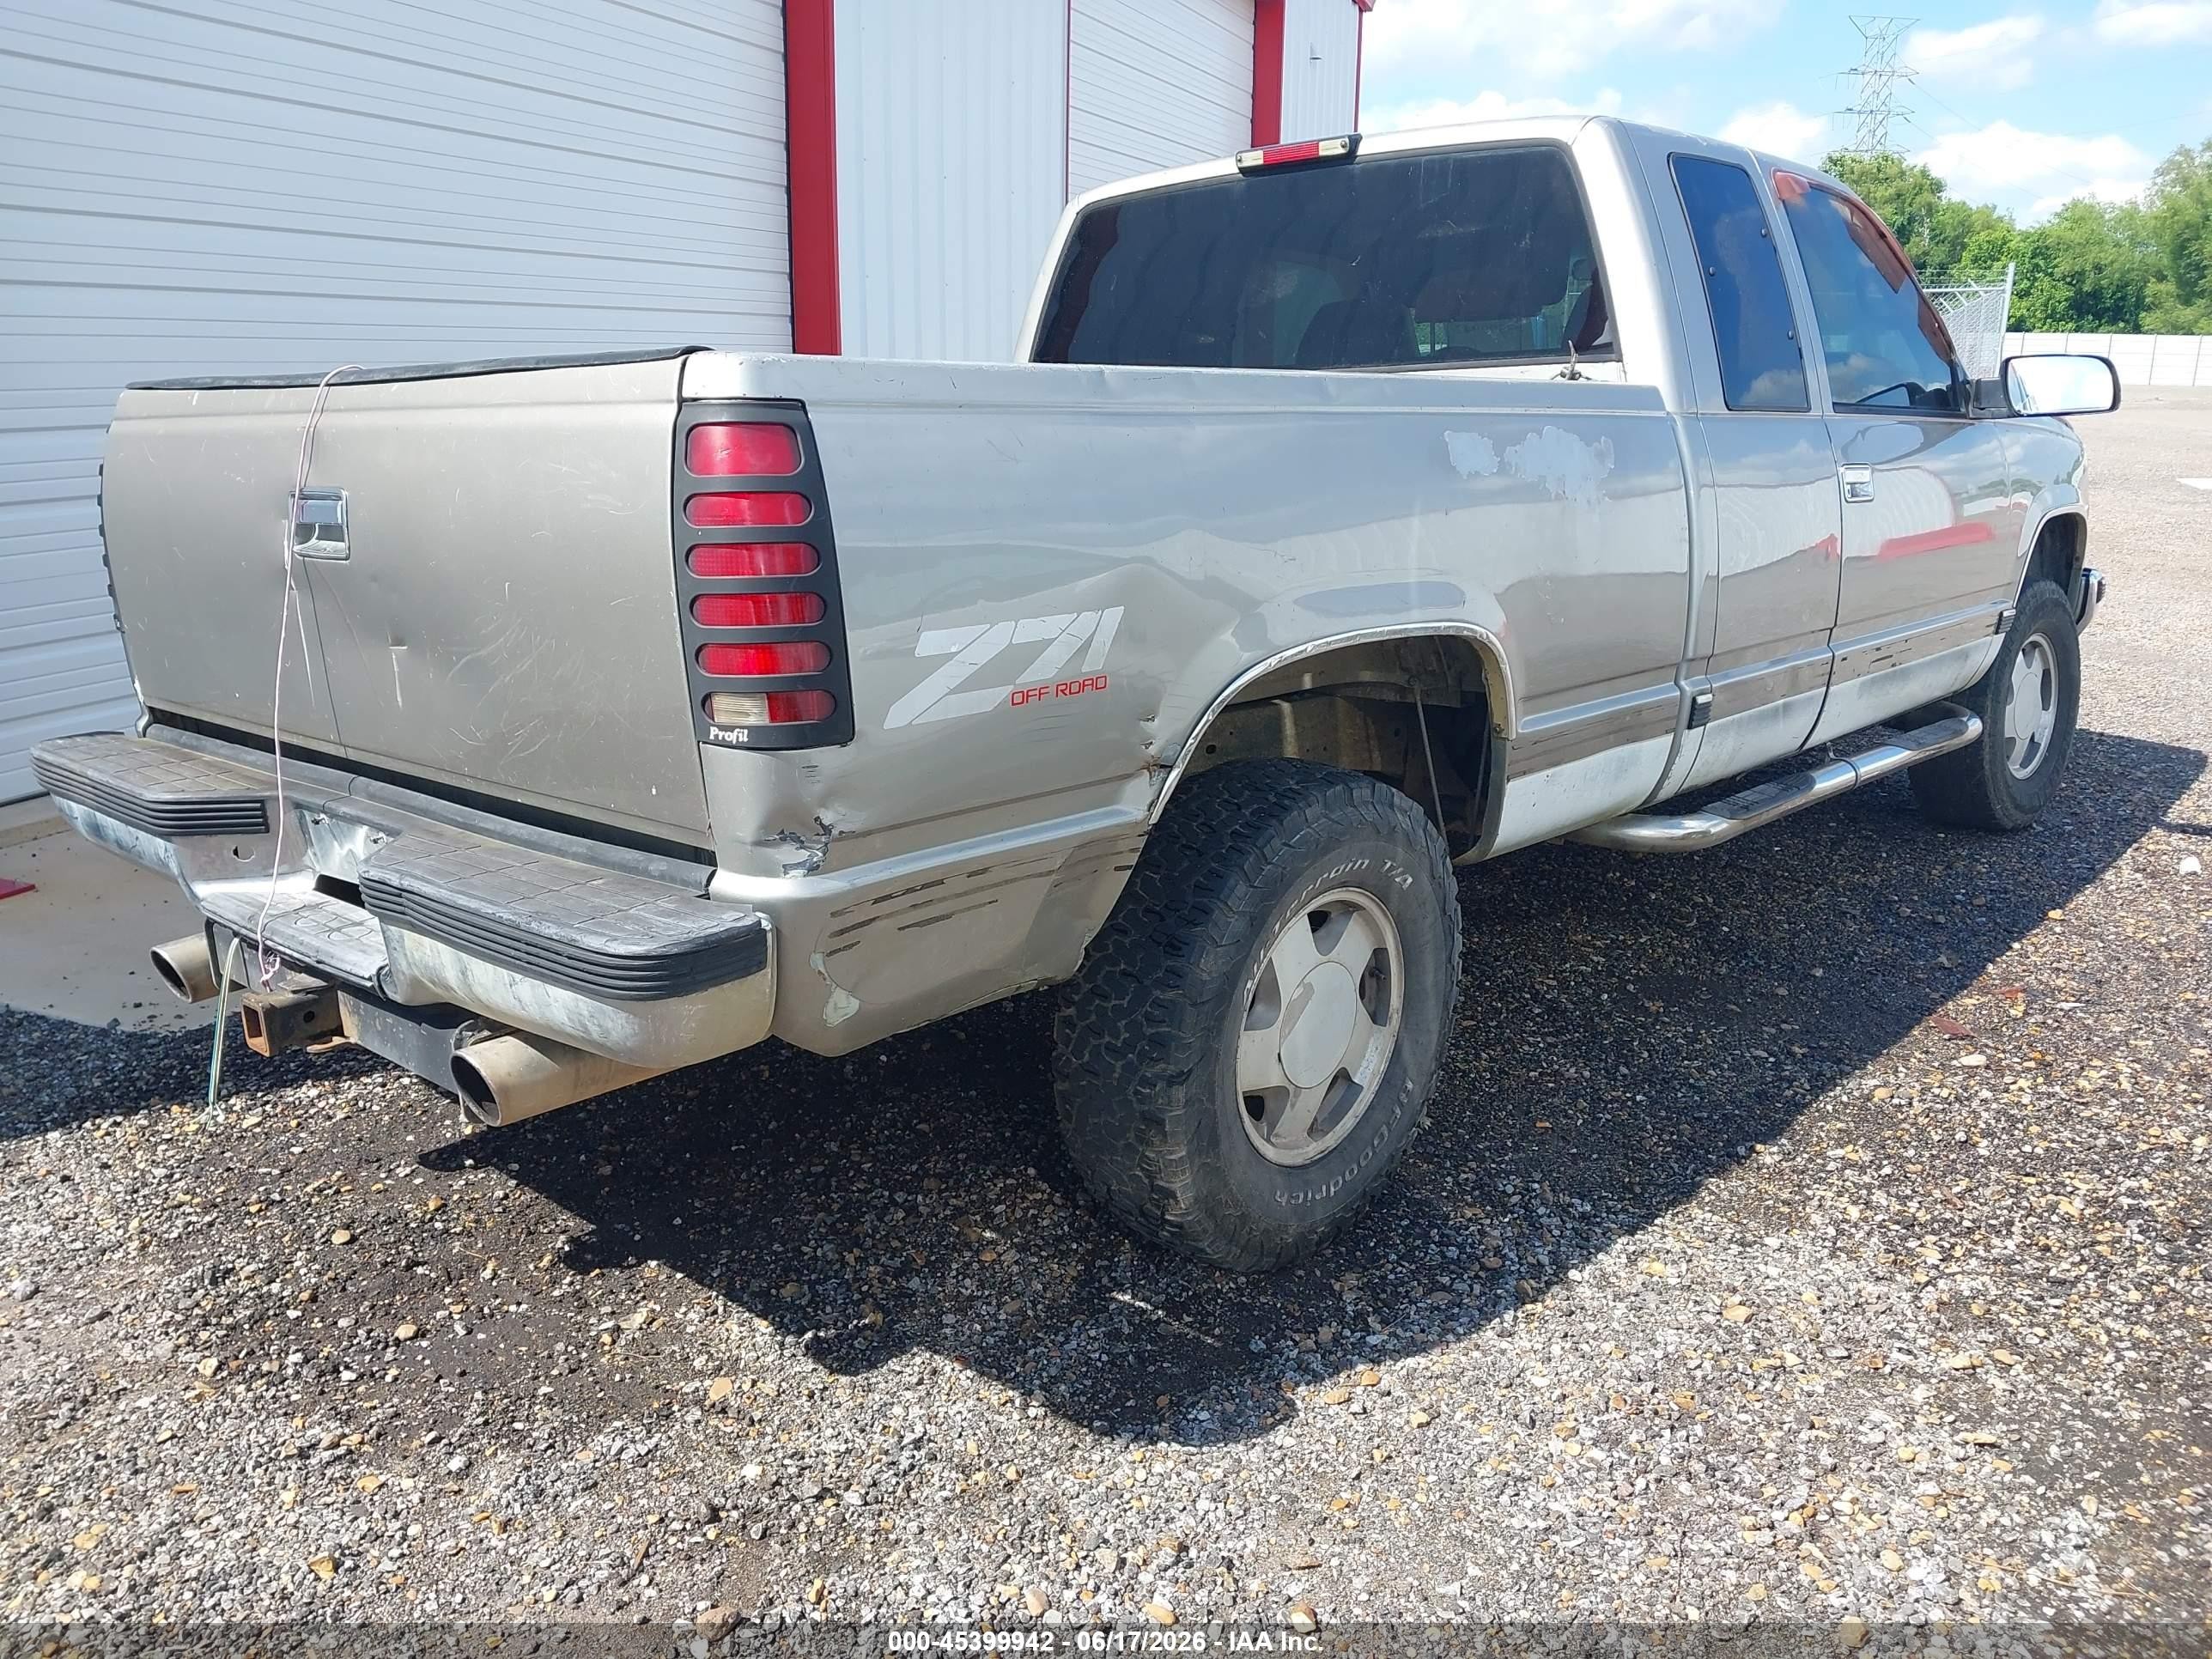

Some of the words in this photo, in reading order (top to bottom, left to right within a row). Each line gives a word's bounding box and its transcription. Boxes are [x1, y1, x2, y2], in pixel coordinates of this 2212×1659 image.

[883, 605, 1125, 730] Z71
[1010, 686, 1049, 707] OFF
[1055, 675, 1108, 698] ROAD
[710, 726, 748, 744] Profil
